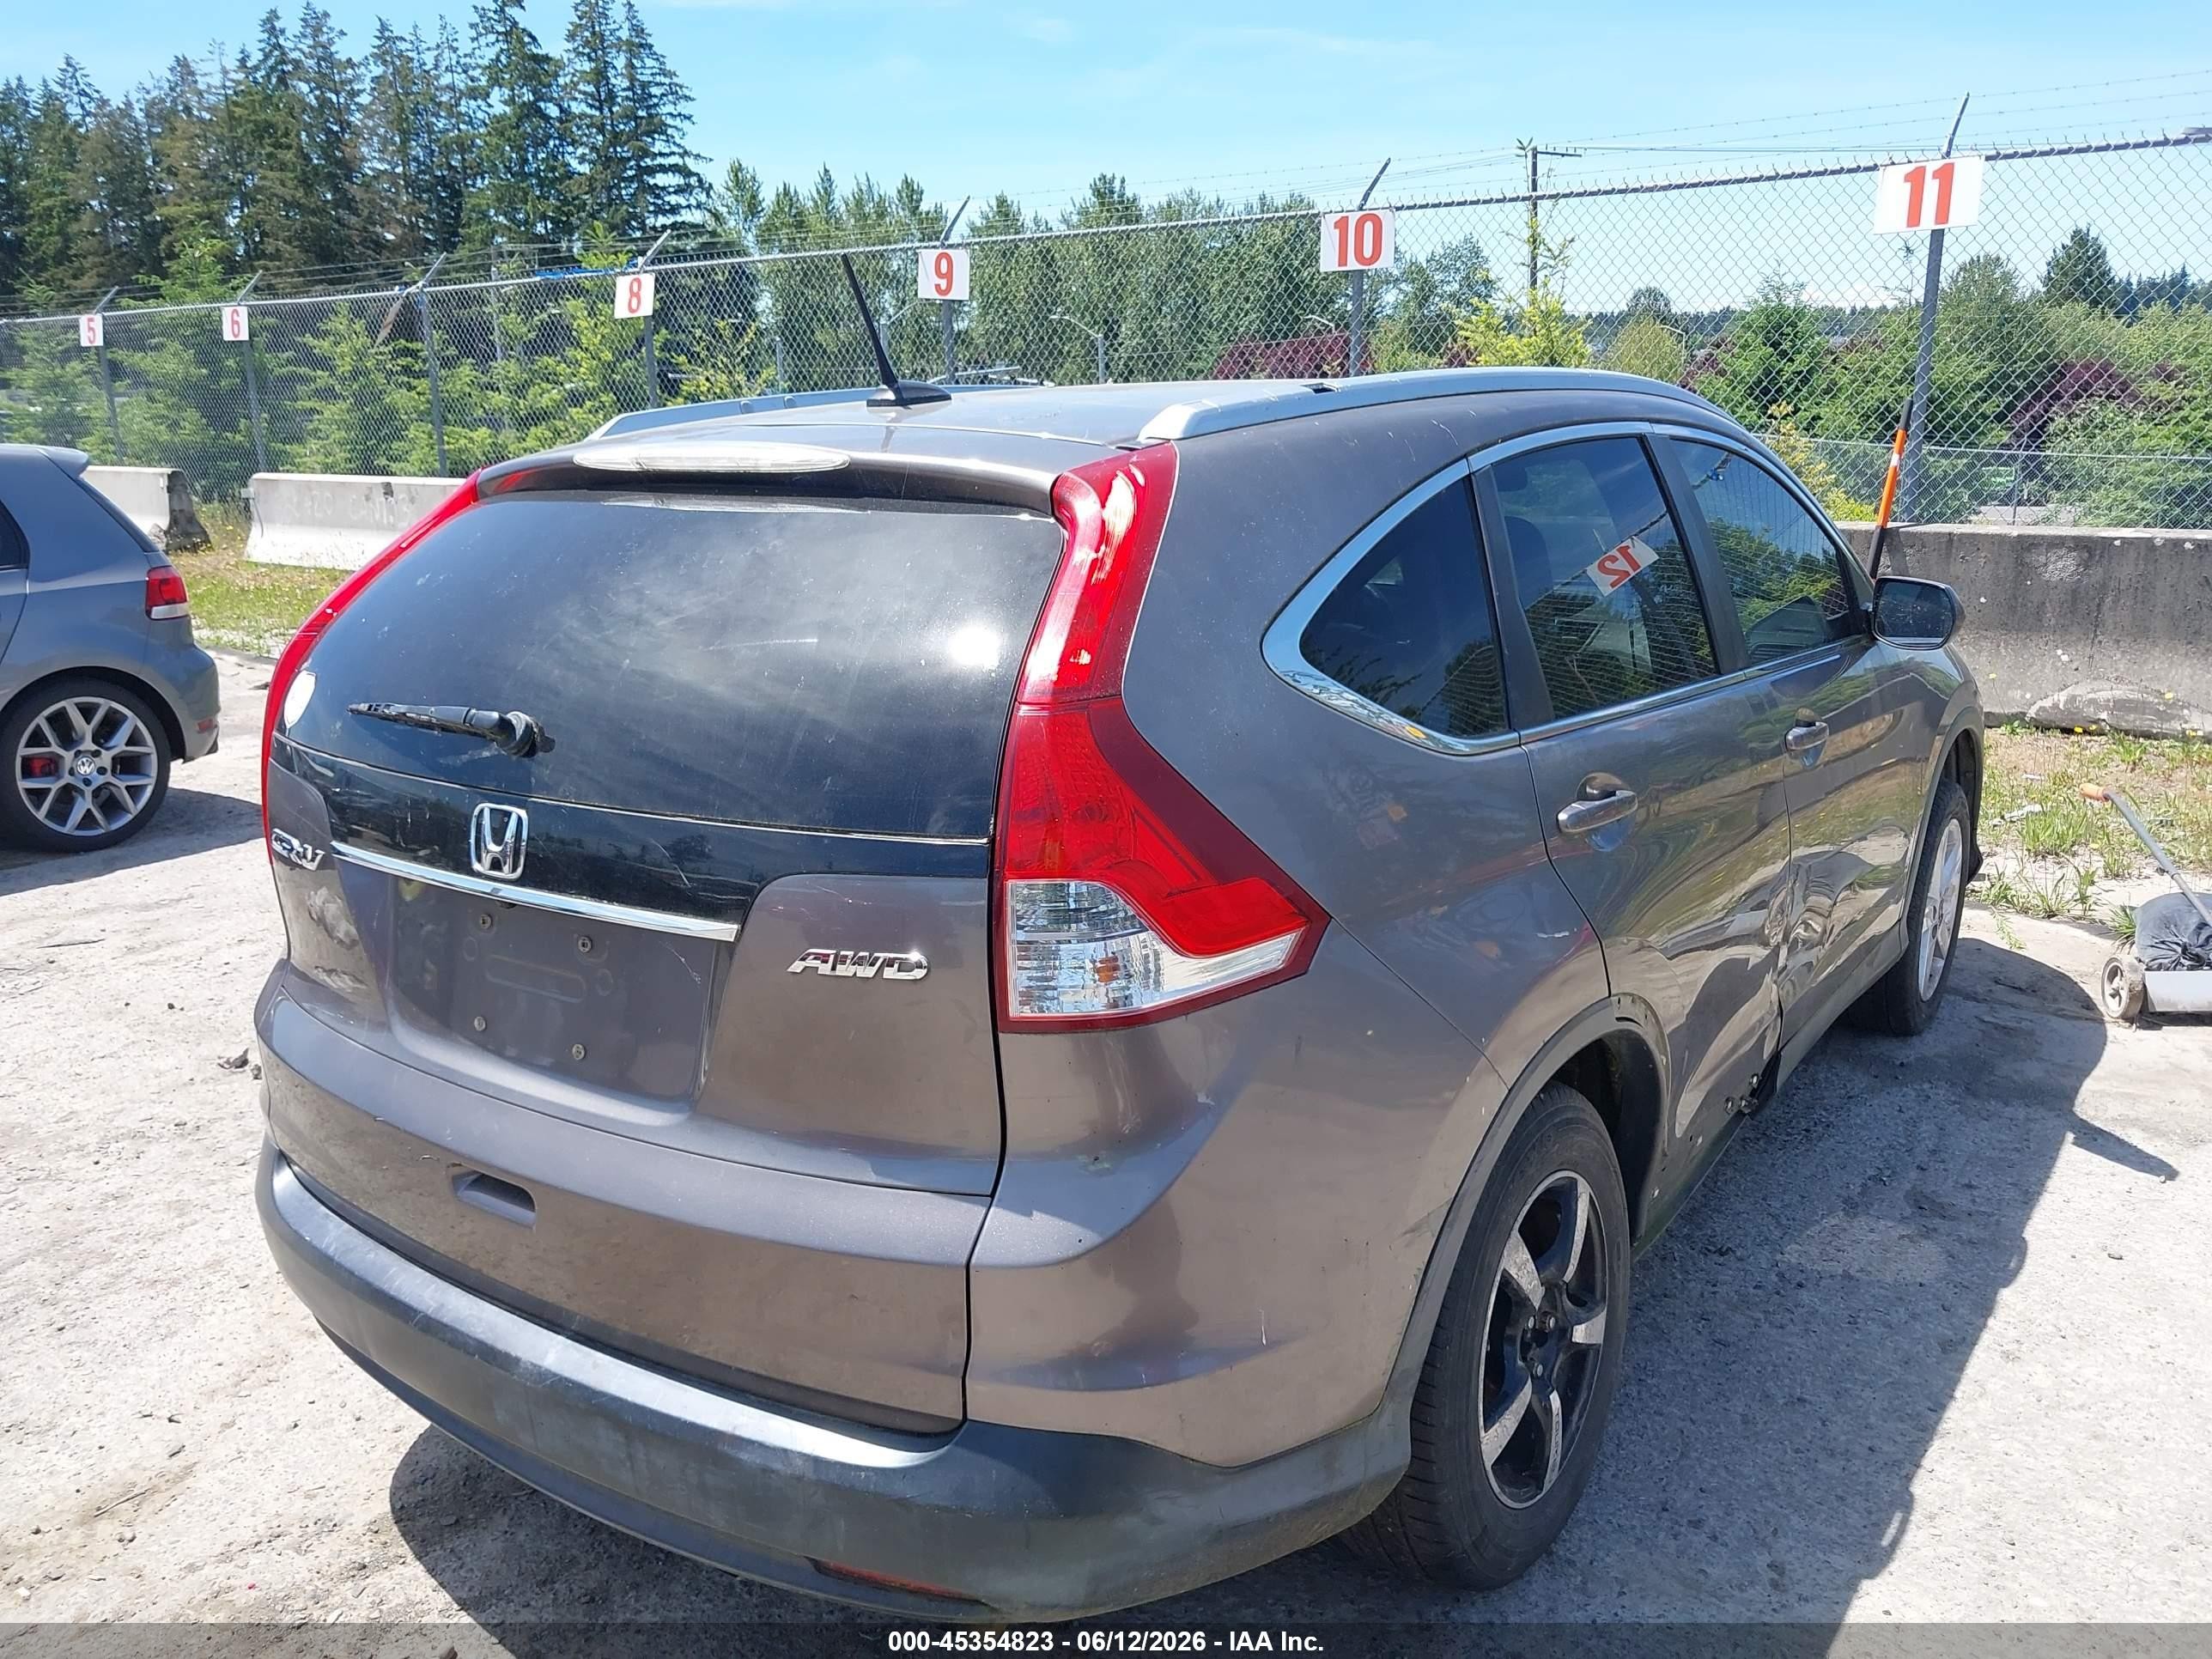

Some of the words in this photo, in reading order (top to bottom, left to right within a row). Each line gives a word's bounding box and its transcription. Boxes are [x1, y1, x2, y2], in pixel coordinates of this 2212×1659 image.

[1904, 162, 1955, 228] 11
[1334, 213, 1382, 267] 10
[934, 252, 953, 296] 9
[628, 277, 641, 313] 8
[87, 318, 96, 344] 5
[230, 308, 240, 338] 6
[787, 948, 928, 980] AWD
